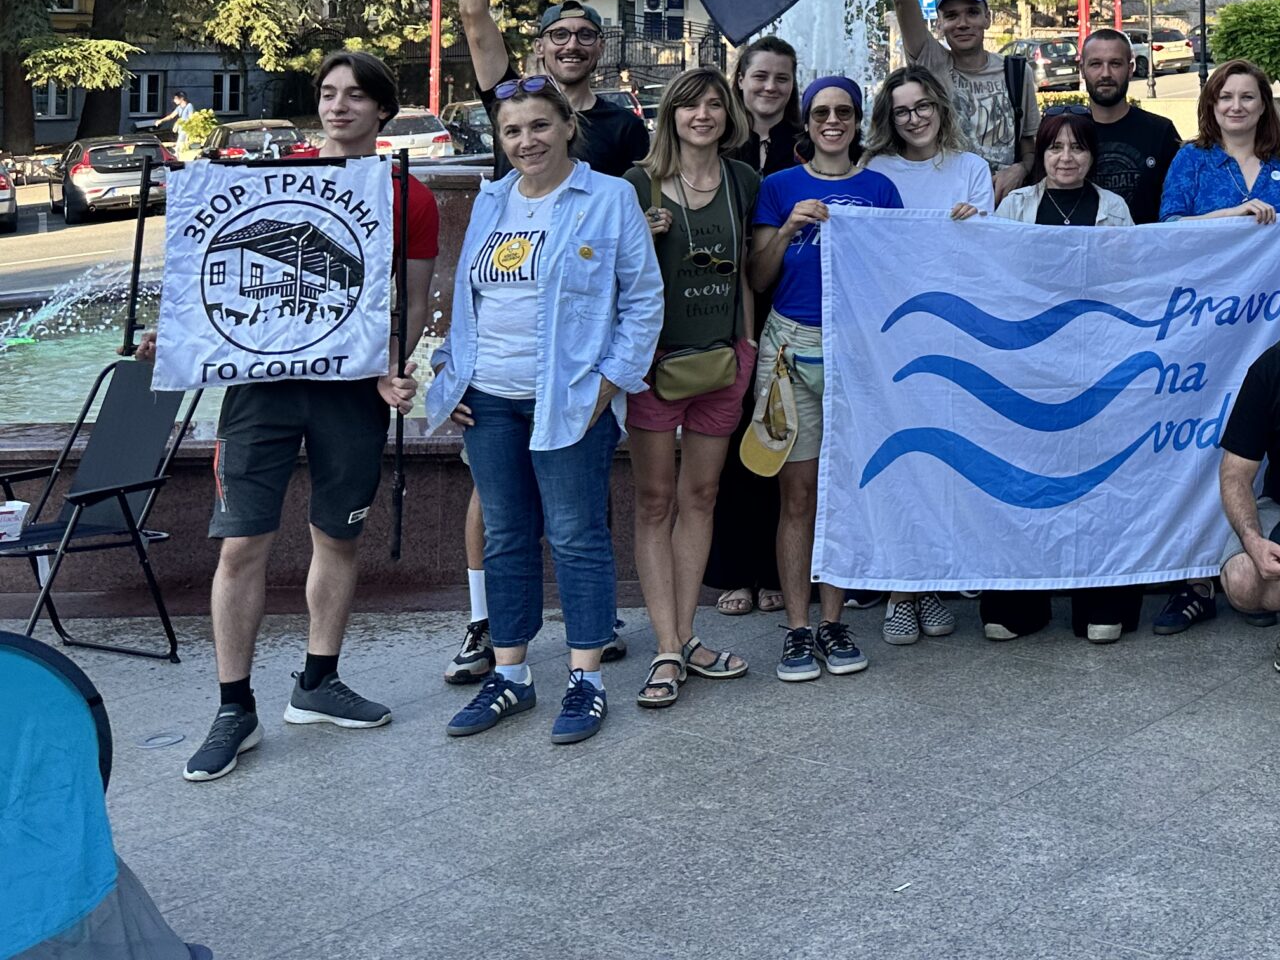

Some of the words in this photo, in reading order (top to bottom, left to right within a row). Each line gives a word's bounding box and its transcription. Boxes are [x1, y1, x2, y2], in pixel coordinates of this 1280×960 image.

[184, 184, 247, 244] ЗБОР
[264, 173, 380, 239] ГРАЂАНА
[684, 283, 732, 298] every
[201, 362, 239, 384] ГО
[247, 355, 349, 380] СОПОТ
[1154, 360, 1209, 395] na
[1149, 391, 1232, 454] vod
